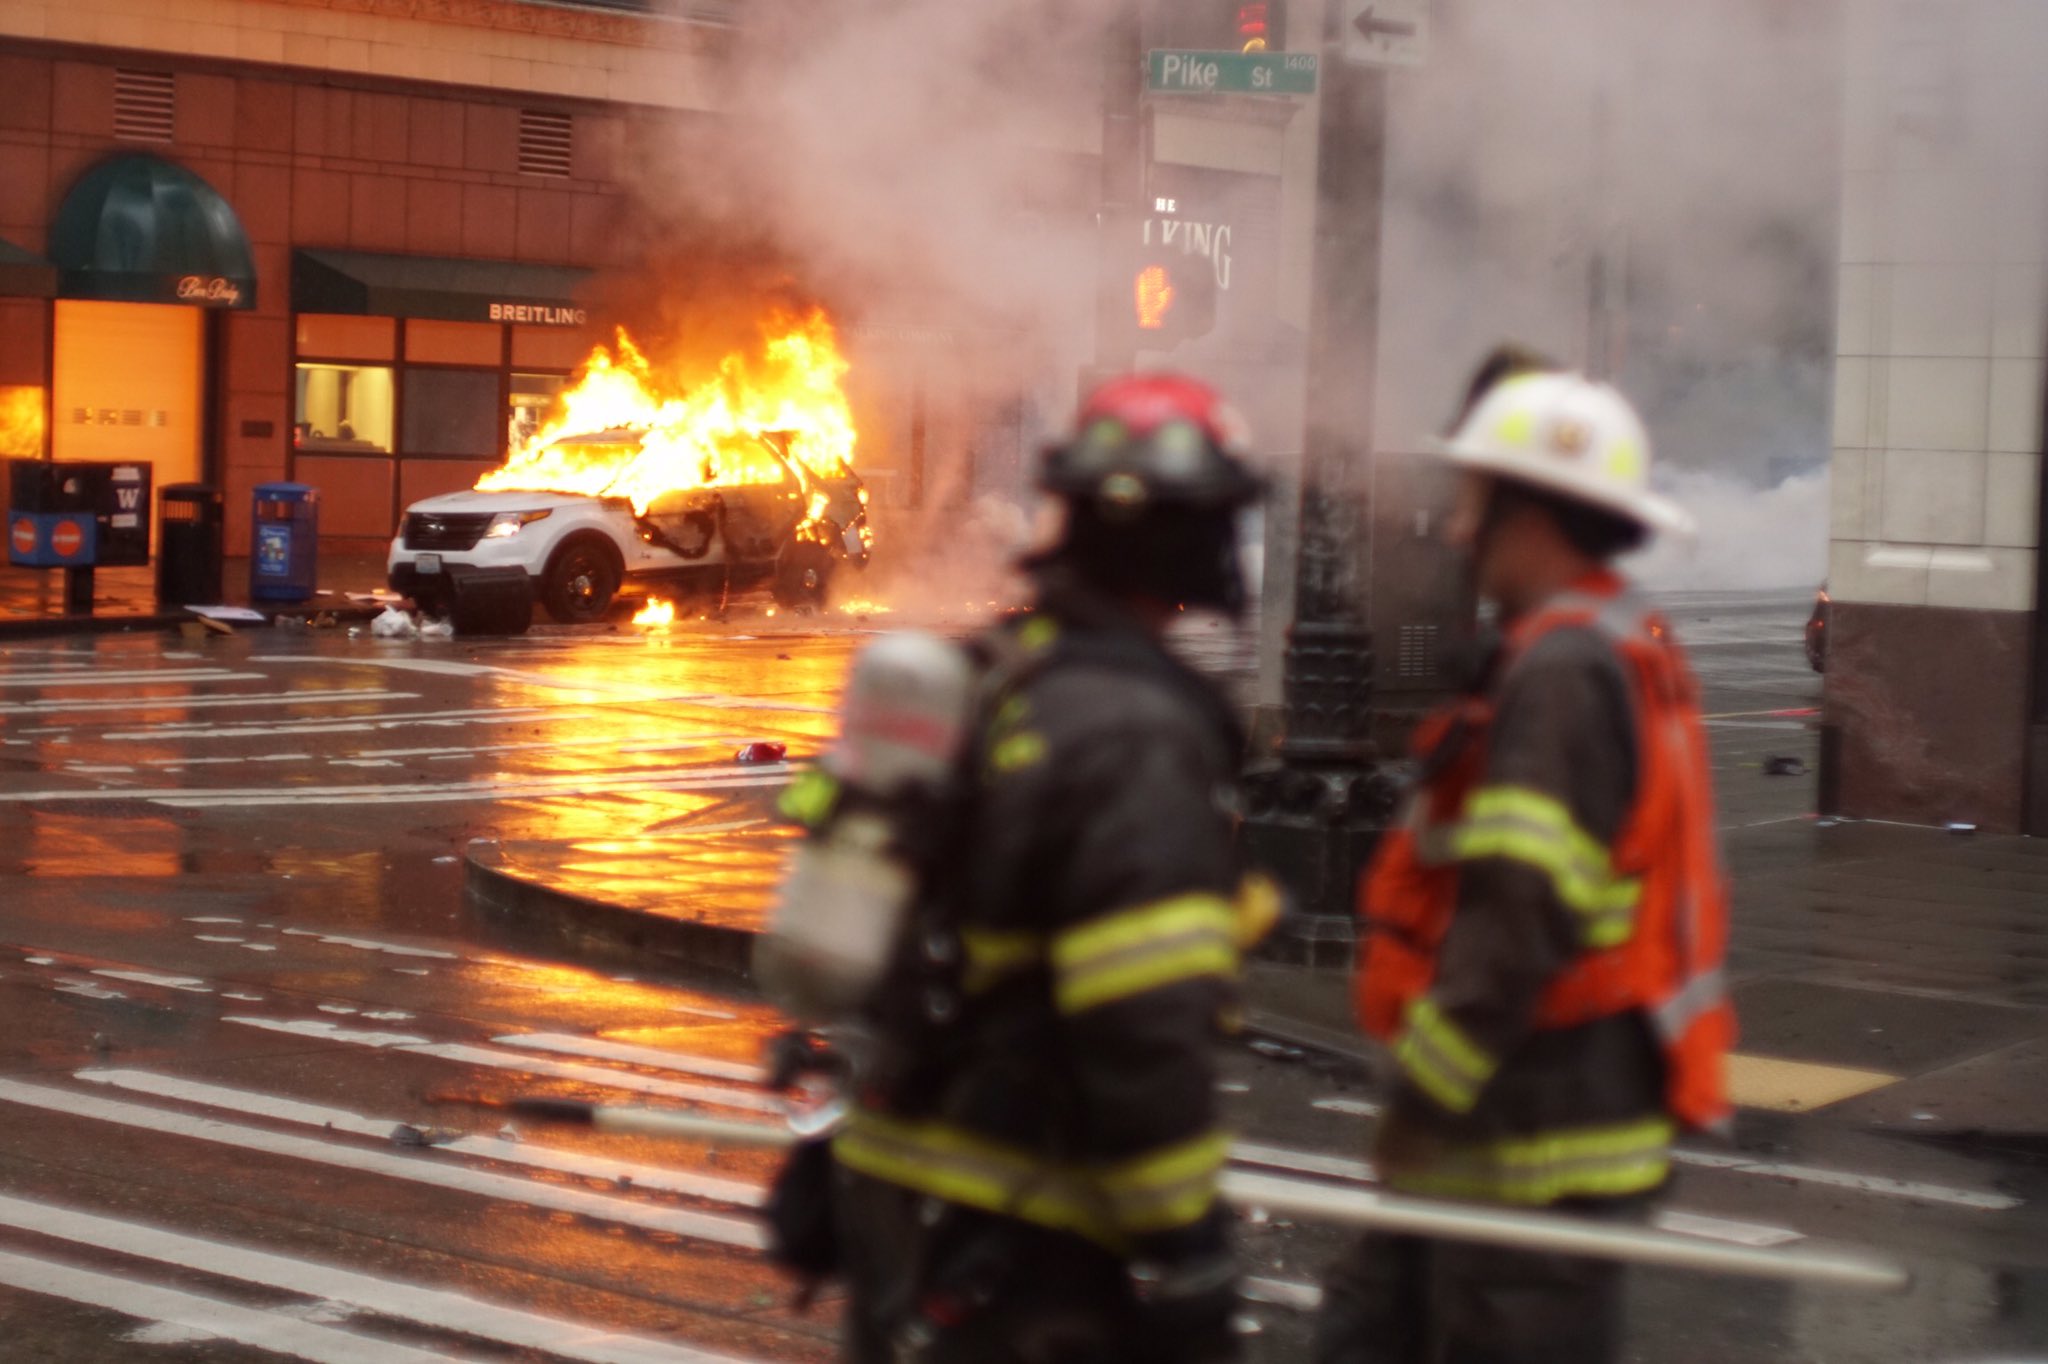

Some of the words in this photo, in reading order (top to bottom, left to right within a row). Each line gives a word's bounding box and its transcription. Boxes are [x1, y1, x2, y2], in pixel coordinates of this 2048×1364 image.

[1163, 54, 1218, 87] Pike
[1252, 66, 1273, 87] St
[1285, 55, 1316, 70] 1400
[1154, 198, 1177, 212] HE
[489, 303, 586, 325] BREITLING
[116, 488, 140, 509] W
